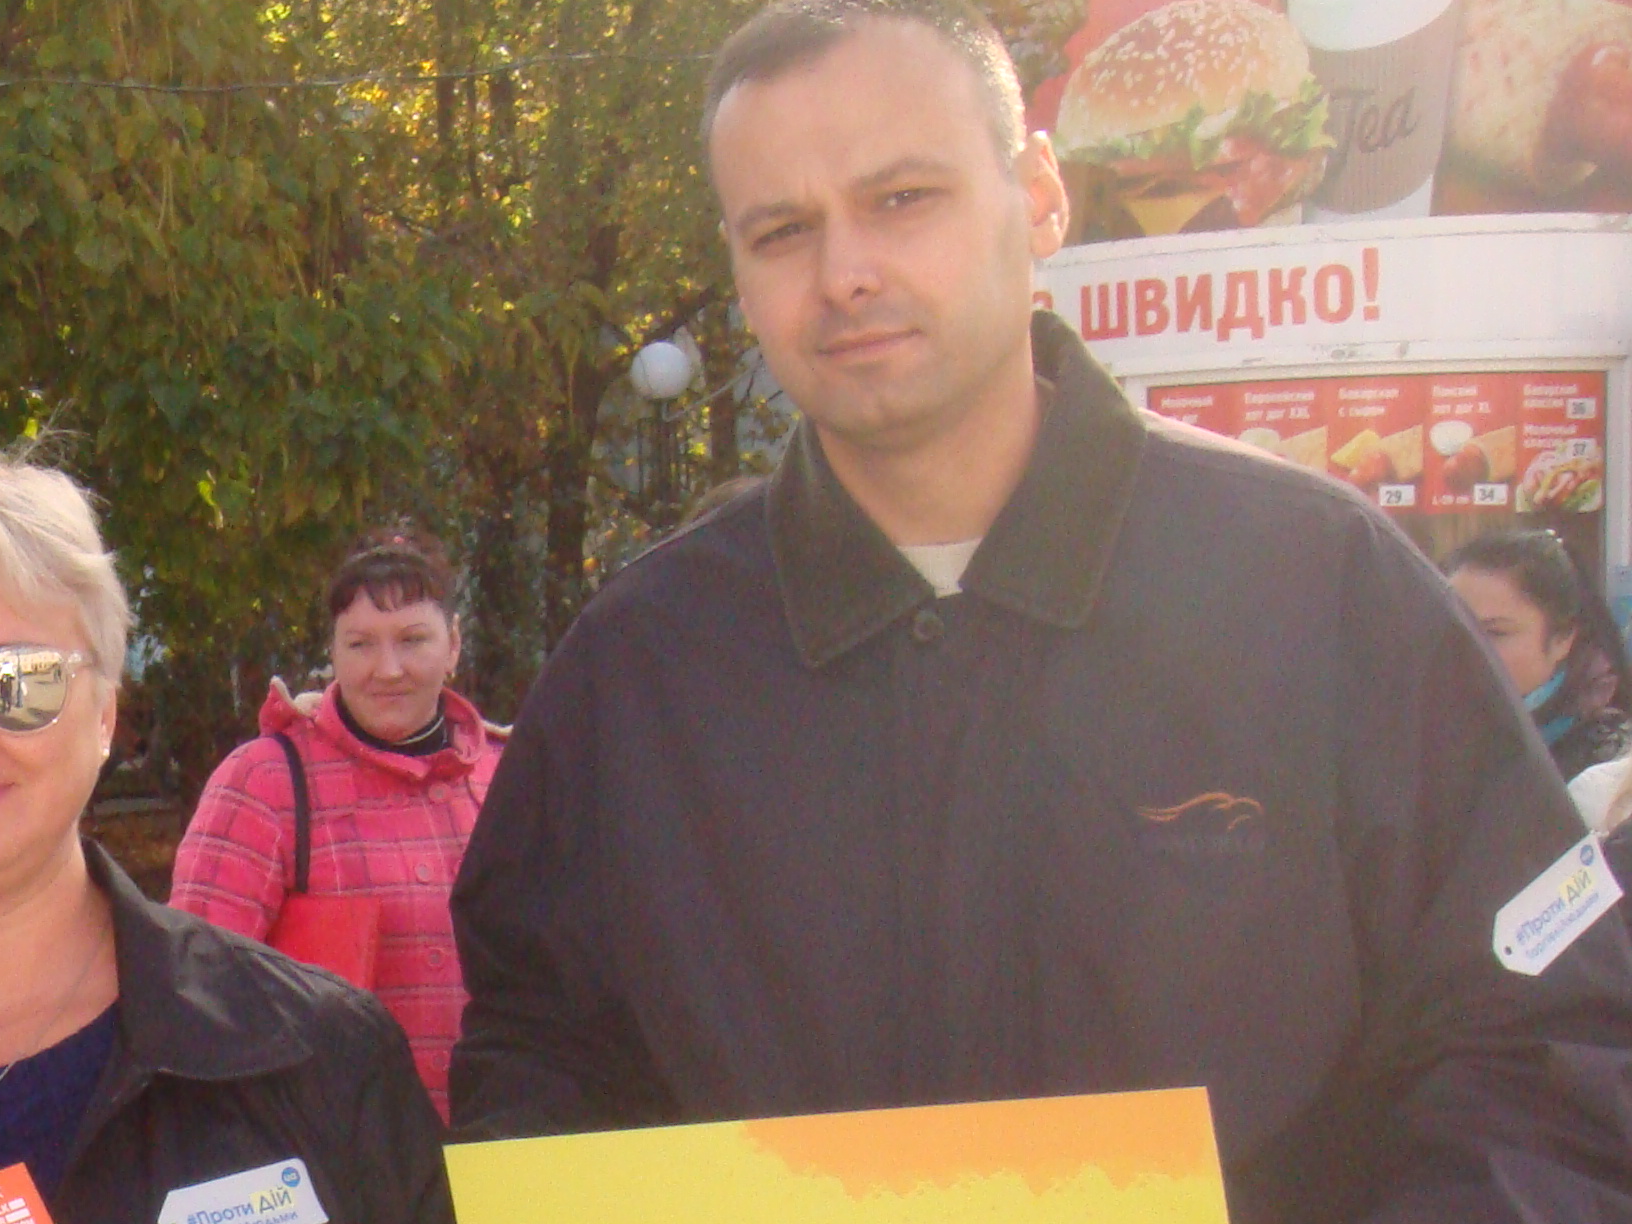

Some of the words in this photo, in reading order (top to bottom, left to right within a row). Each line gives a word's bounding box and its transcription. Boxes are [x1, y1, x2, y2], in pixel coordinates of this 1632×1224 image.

[1329, 86, 1418, 153] Tea
[1079, 246, 1380, 342] ШВИДКО!
[1385, 489, 1403, 505] 29
